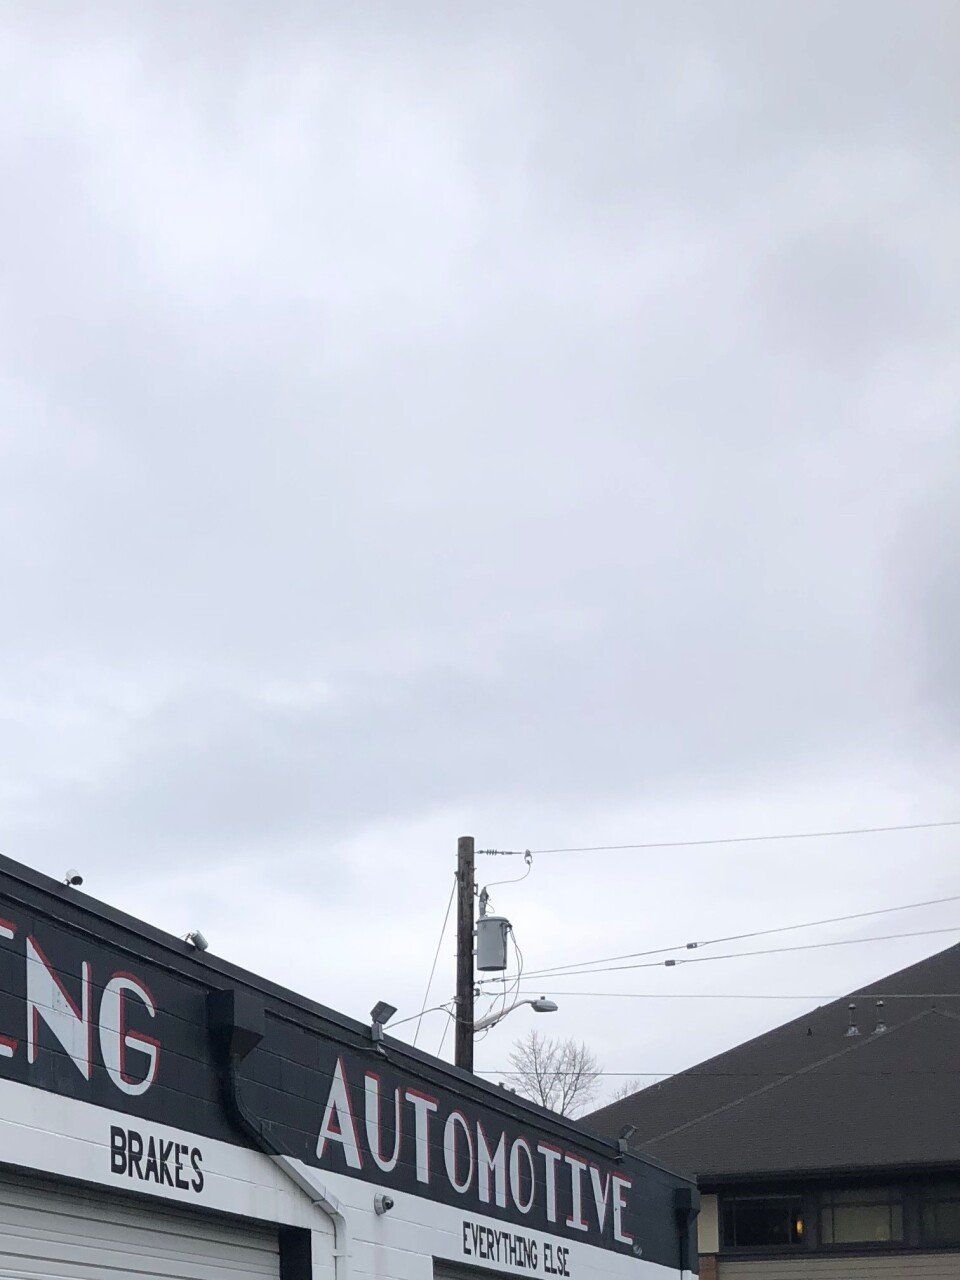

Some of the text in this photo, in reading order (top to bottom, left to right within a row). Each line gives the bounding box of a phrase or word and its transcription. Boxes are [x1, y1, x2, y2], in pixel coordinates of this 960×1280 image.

[110, 1125, 204, 1194] BRAKES
[316, 1056, 635, 1246] AUTOMOTIVE
[463, 1220, 570, 1278] EVERYTHING ELSE
